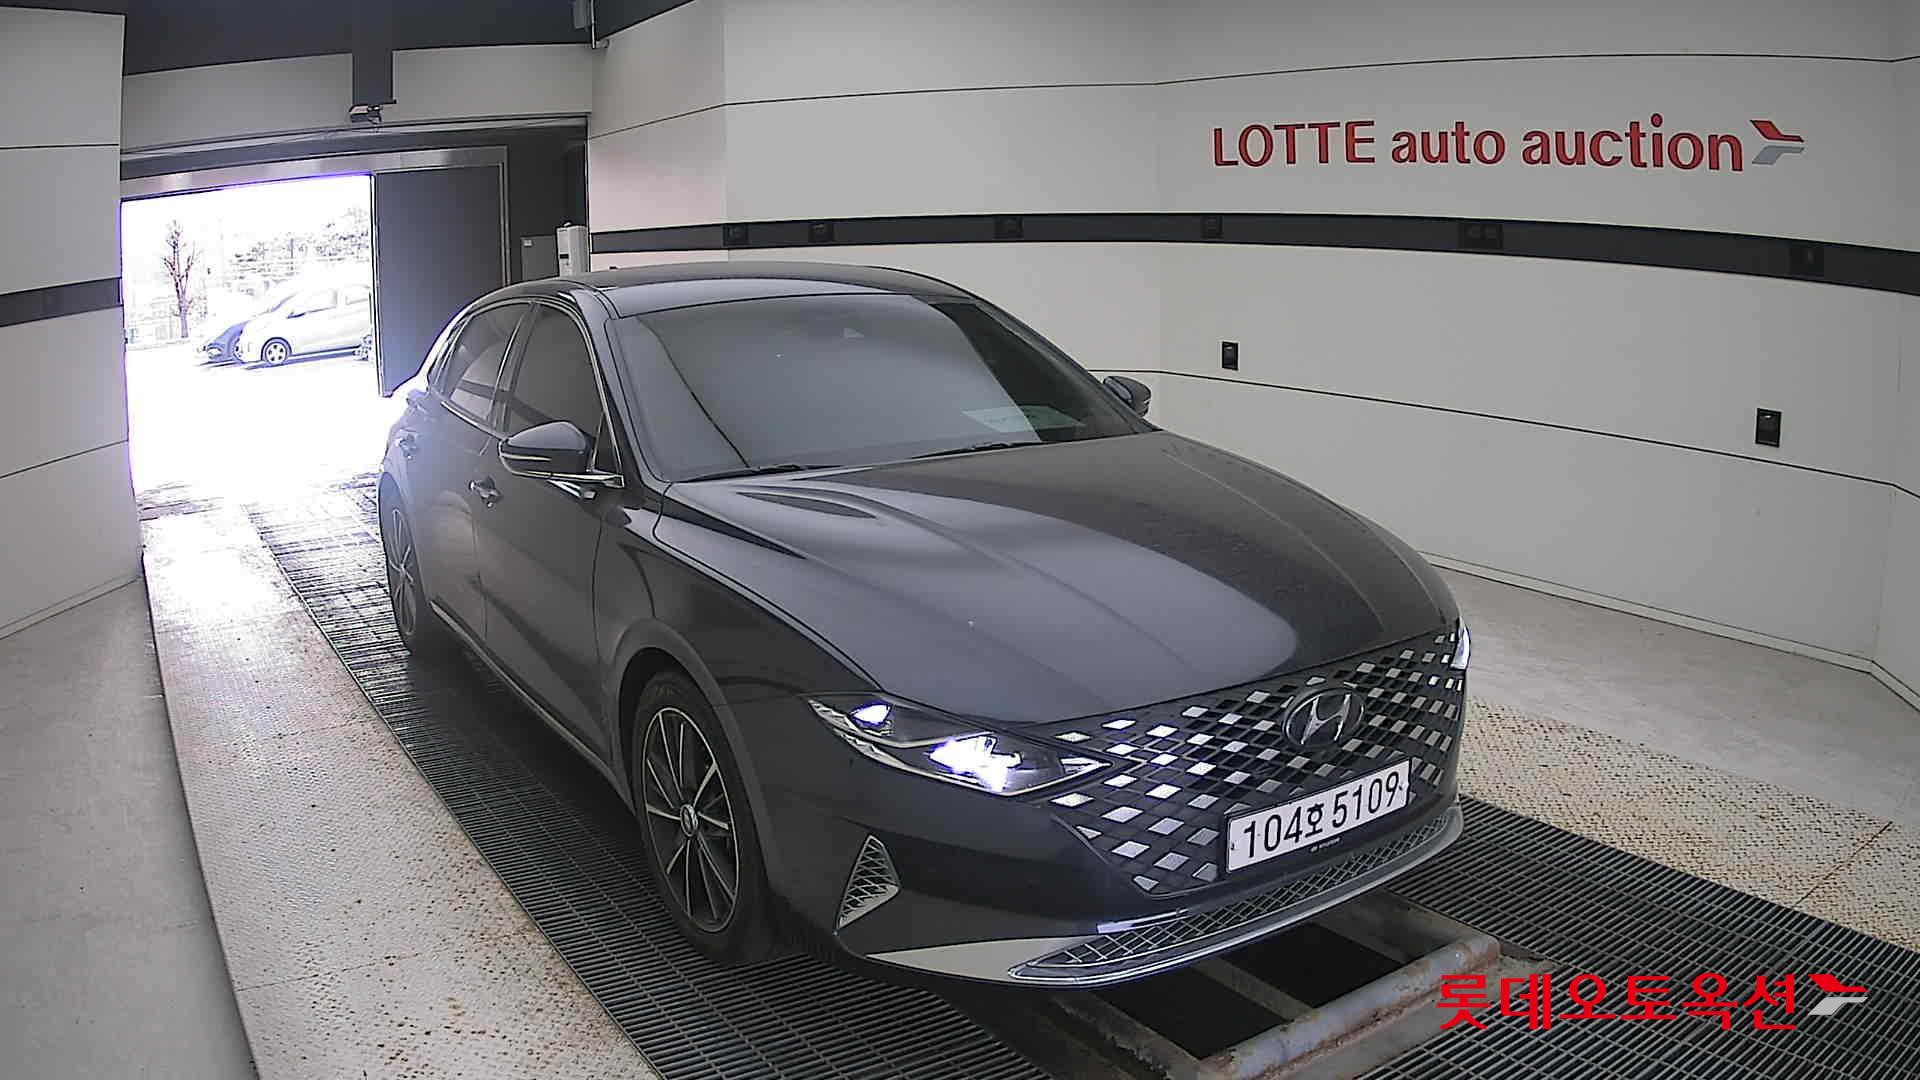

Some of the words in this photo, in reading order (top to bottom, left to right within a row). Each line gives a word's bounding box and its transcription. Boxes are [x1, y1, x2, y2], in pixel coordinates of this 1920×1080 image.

[1214, 120, 1375, 167] LOTTE
[1391, 121, 1506, 165] auto
[1521, 112, 1744, 171] auction
